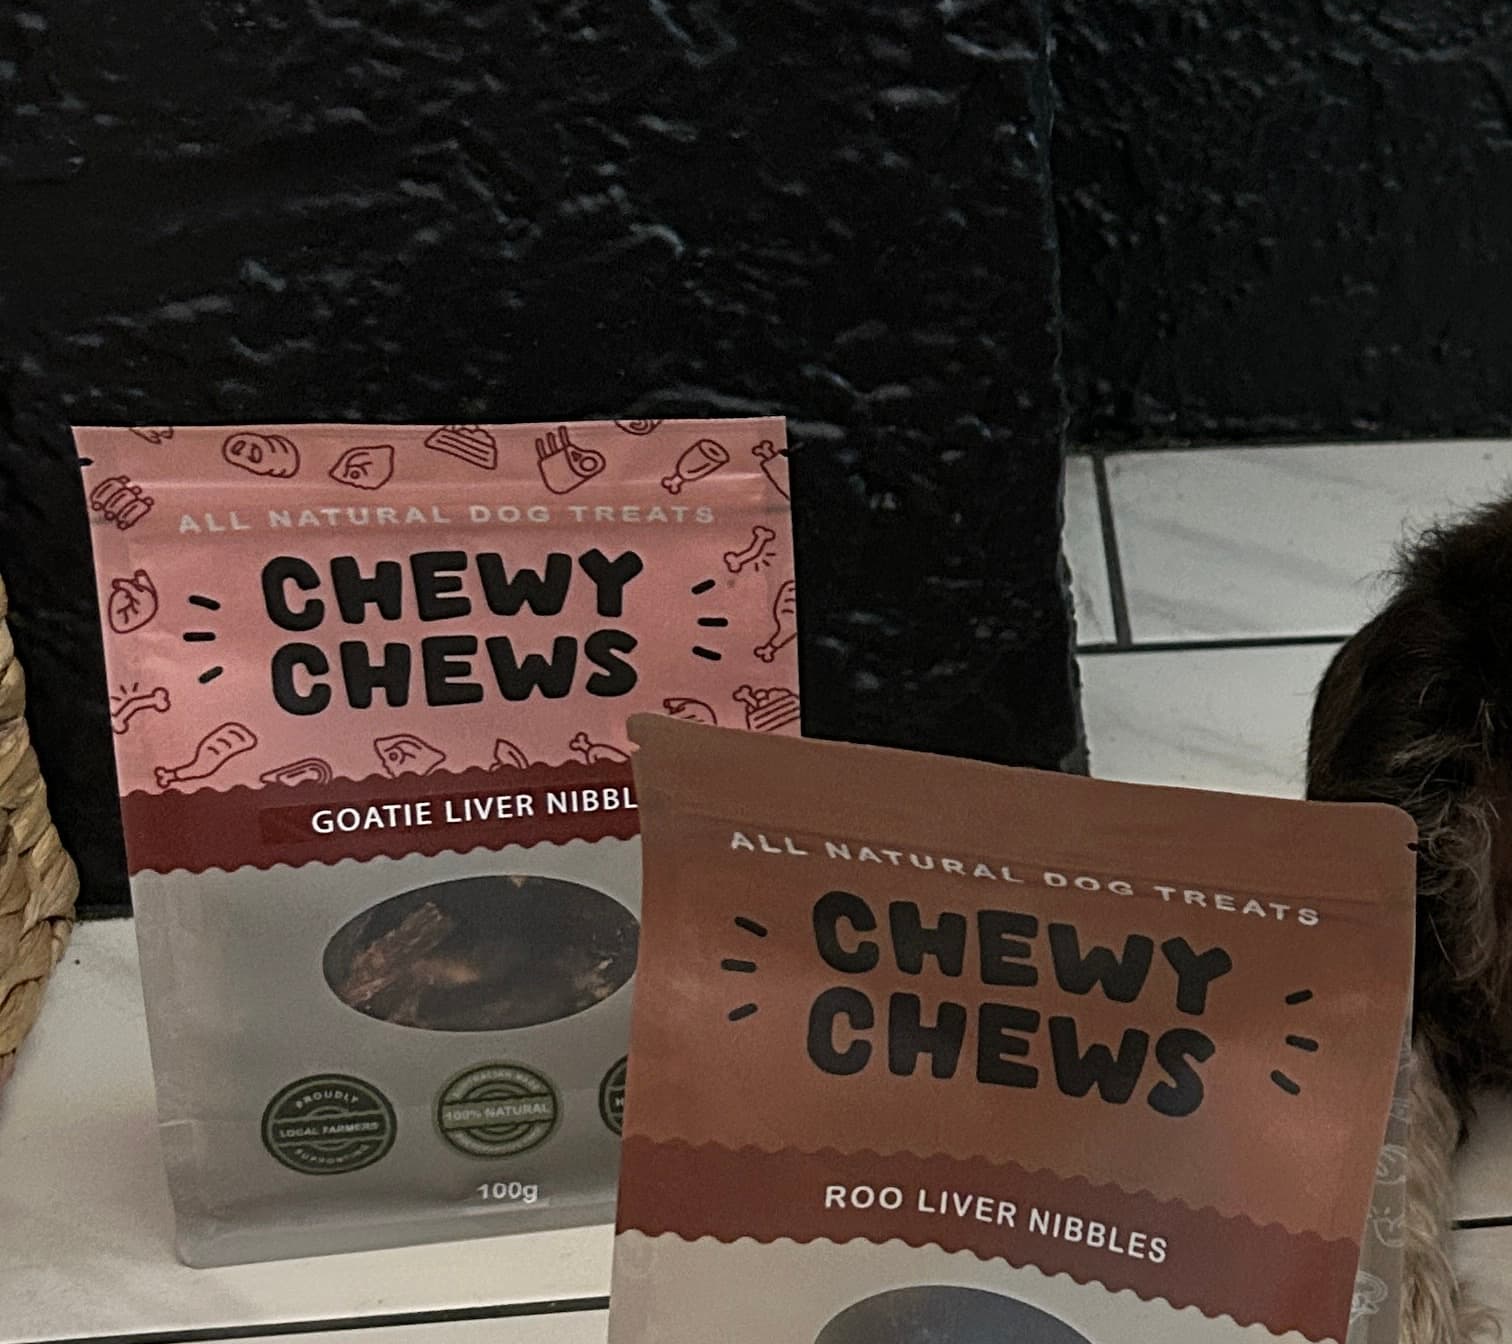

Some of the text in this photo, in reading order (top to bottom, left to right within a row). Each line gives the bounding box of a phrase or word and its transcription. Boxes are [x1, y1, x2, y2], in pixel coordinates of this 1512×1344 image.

[179, 505, 715, 534] ALL NATURAL DOG TREATS
[261, 548, 644, 631] CHEWY
[270, 629, 639, 715] CHEWS
[311, 787, 639, 834] GOATIE LIVER NIBBL
[731, 830, 1320, 926] ALL NATURAL DOG TREATS
[812, 890, 1233, 1016] CHEWY
[807, 986, 1216, 1118] CHEWS
[279, 1128, 320, 1139] LOCAL
[295, 1090, 359, 1109] PROUDLY
[477, 1181, 538, 1204] 100g
[824, 1185, 1168, 1264] ROO LIVER NIBBLES
